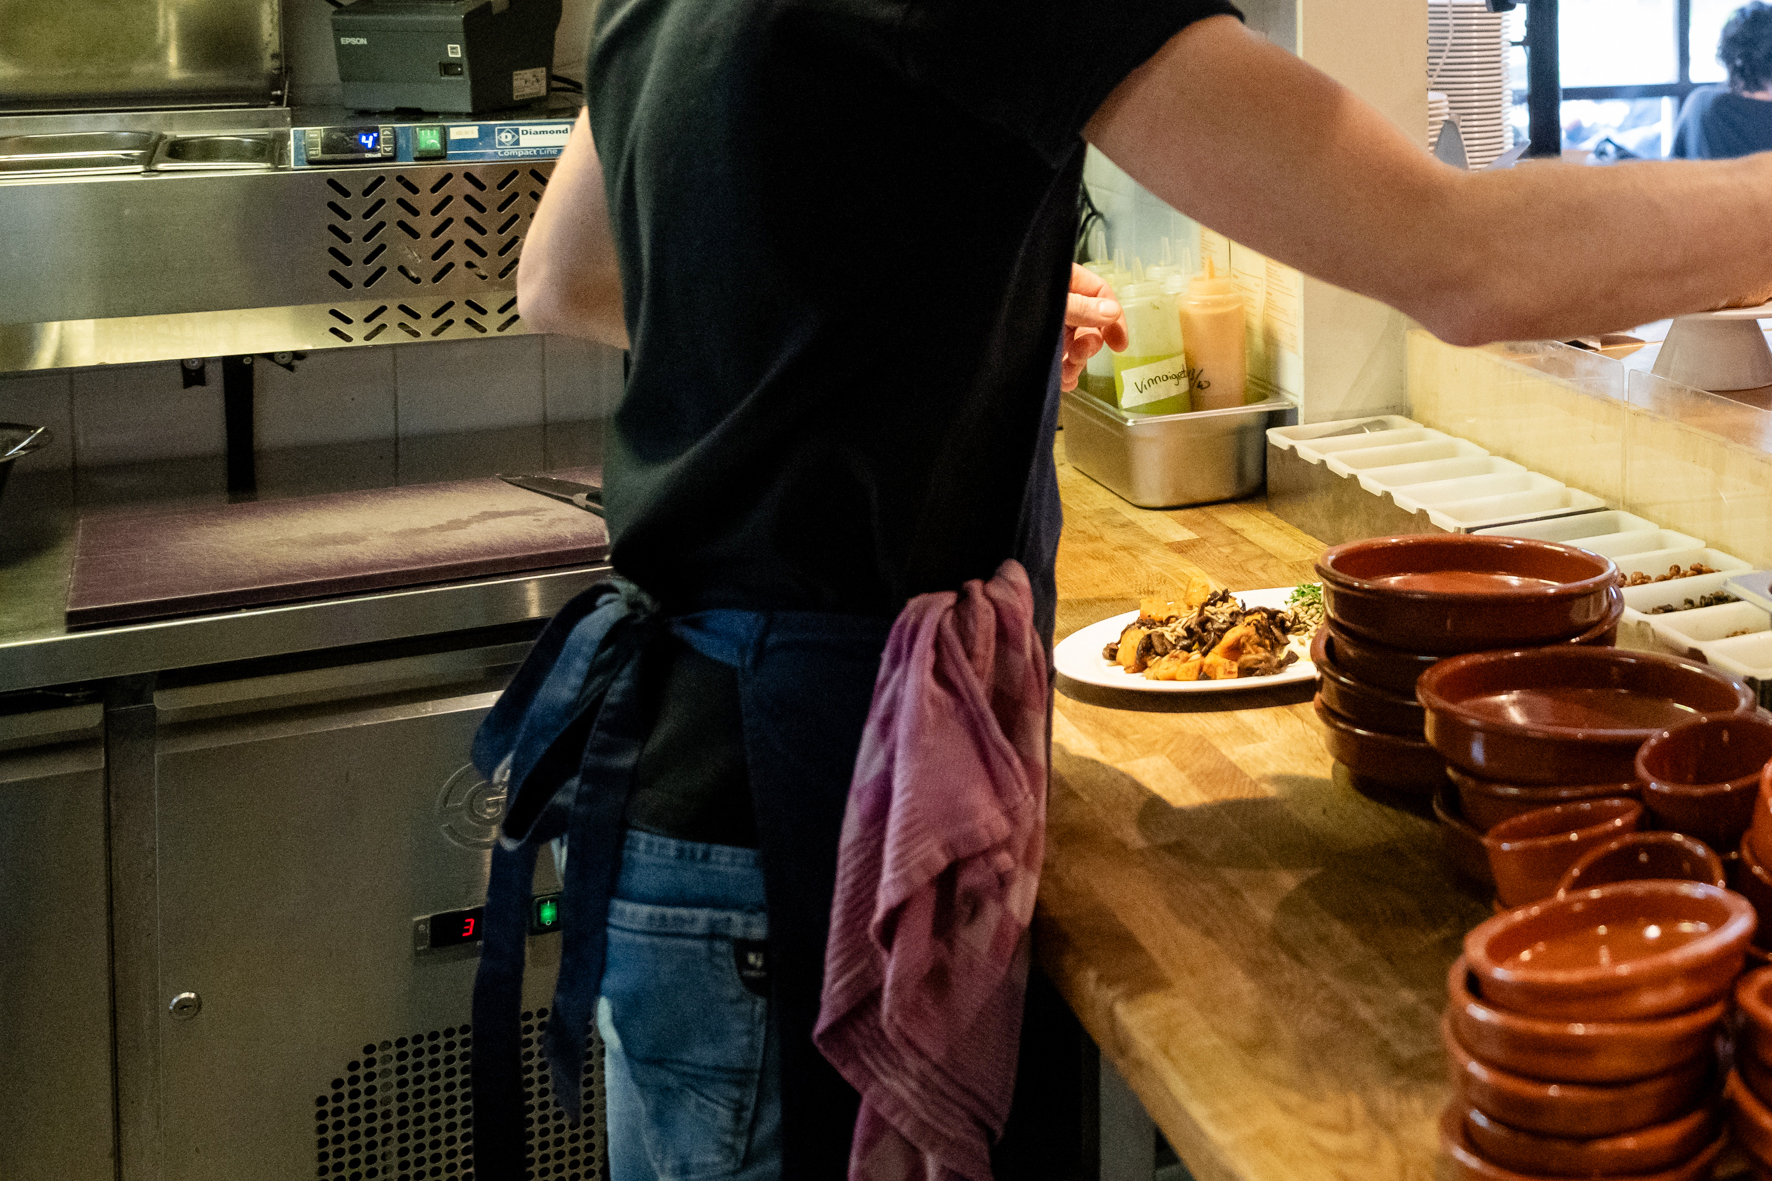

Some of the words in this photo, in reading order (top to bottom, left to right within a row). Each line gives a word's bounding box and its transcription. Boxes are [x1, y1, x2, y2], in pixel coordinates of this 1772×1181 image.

[340, 37, 368, 45] EPSON
[521, 128, 569, 136] Diamond
[498, 149, 537, 157] Compact
[462, 918, 475, 937] 3
